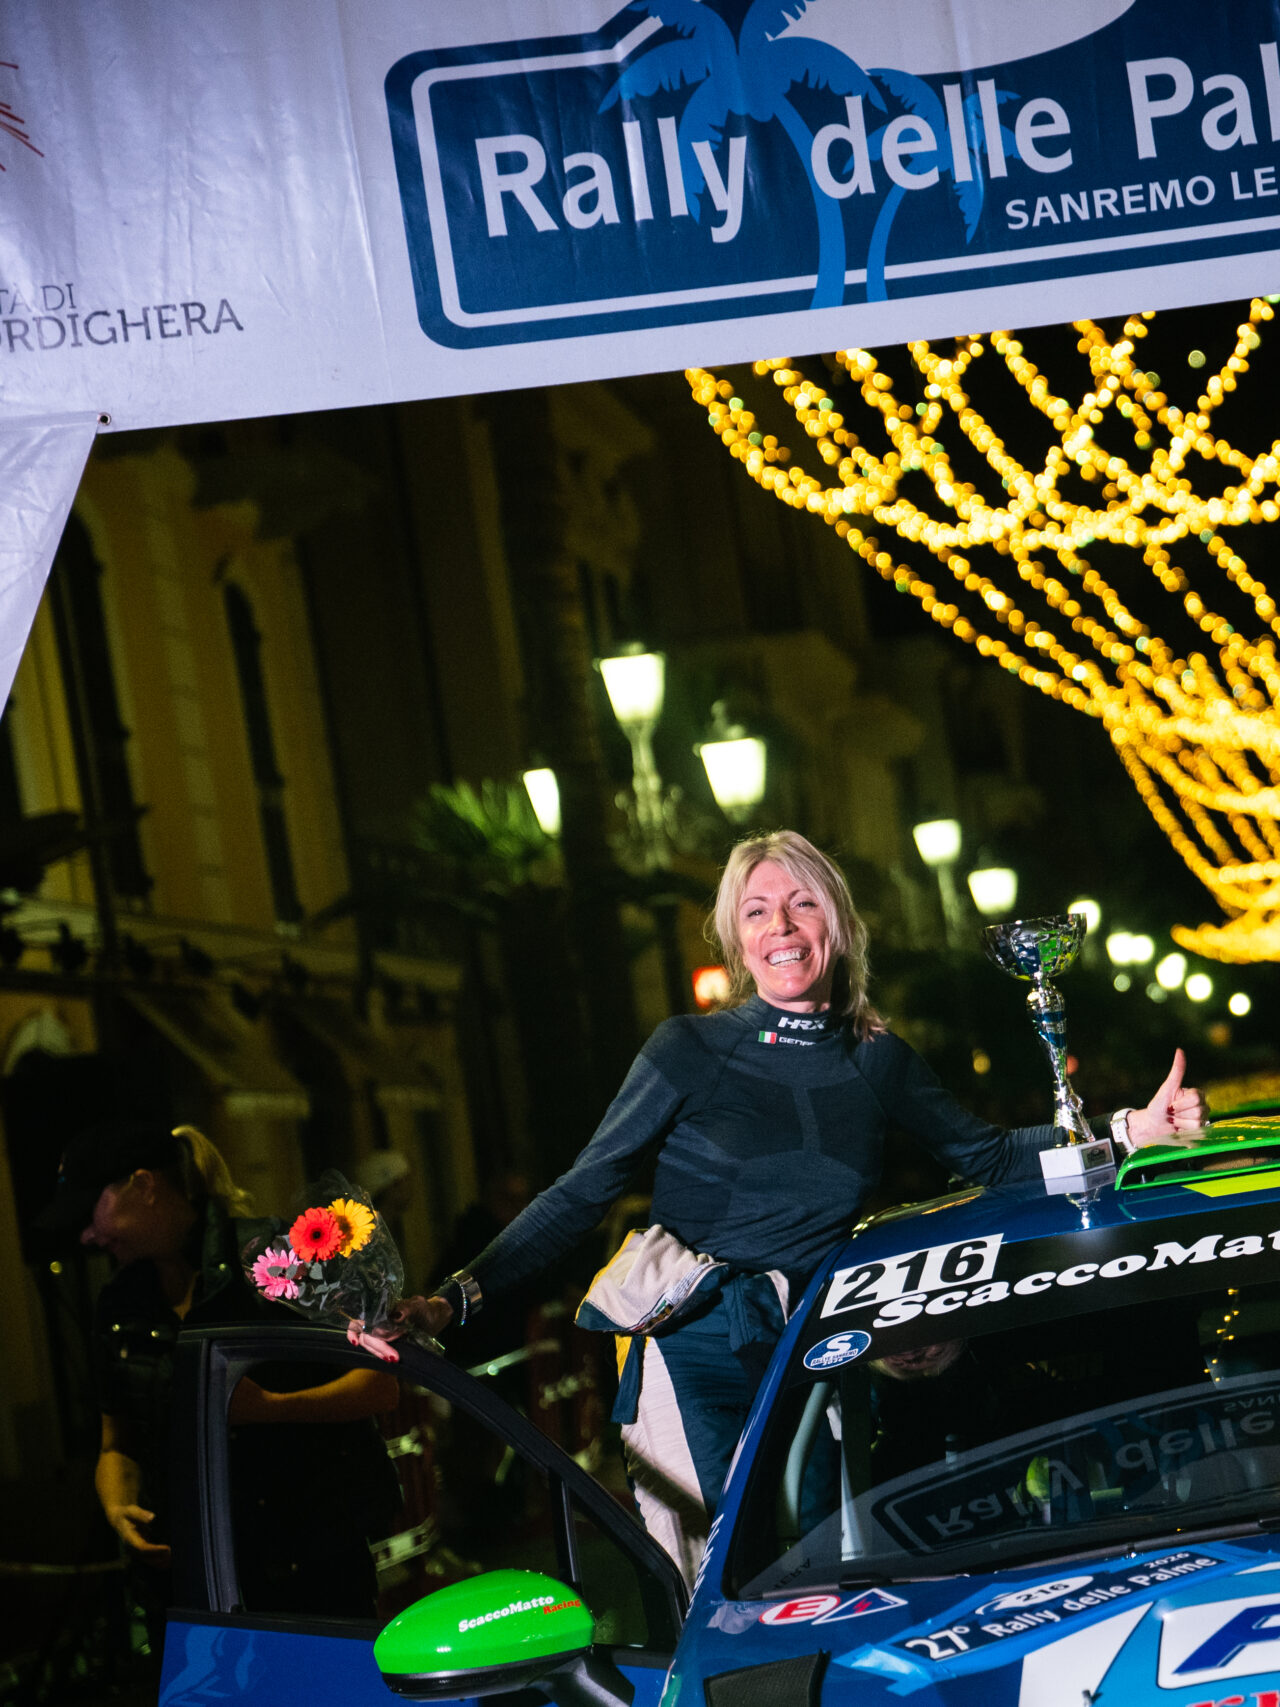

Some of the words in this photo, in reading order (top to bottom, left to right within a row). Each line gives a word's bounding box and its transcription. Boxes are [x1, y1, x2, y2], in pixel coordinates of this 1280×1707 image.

[475, 117, 747, 243] Rally
[810, 79, 1072, 200] delle
[1005, 175, 1216, 231] SANREMO
[41, 283, 77, 312] DI
[0, 298, 244, 353] RDIGHERA
[777, 1016, 827, 1031] HRX
[834, 1240, 989, 1313] 216
[1144, 1552, 1190, 1568] 2026
[543, 1599, 581, 1615] Racing
[981, 1609, 1060, 1638] Rally
[1062, 1584, 1132, 1613] delle
[1128, 1555, 1219, 1587] Palme
[1016, 1581, 1073, 1604] 216
[458, 1596, 555, 1633] ScaccoMatto
